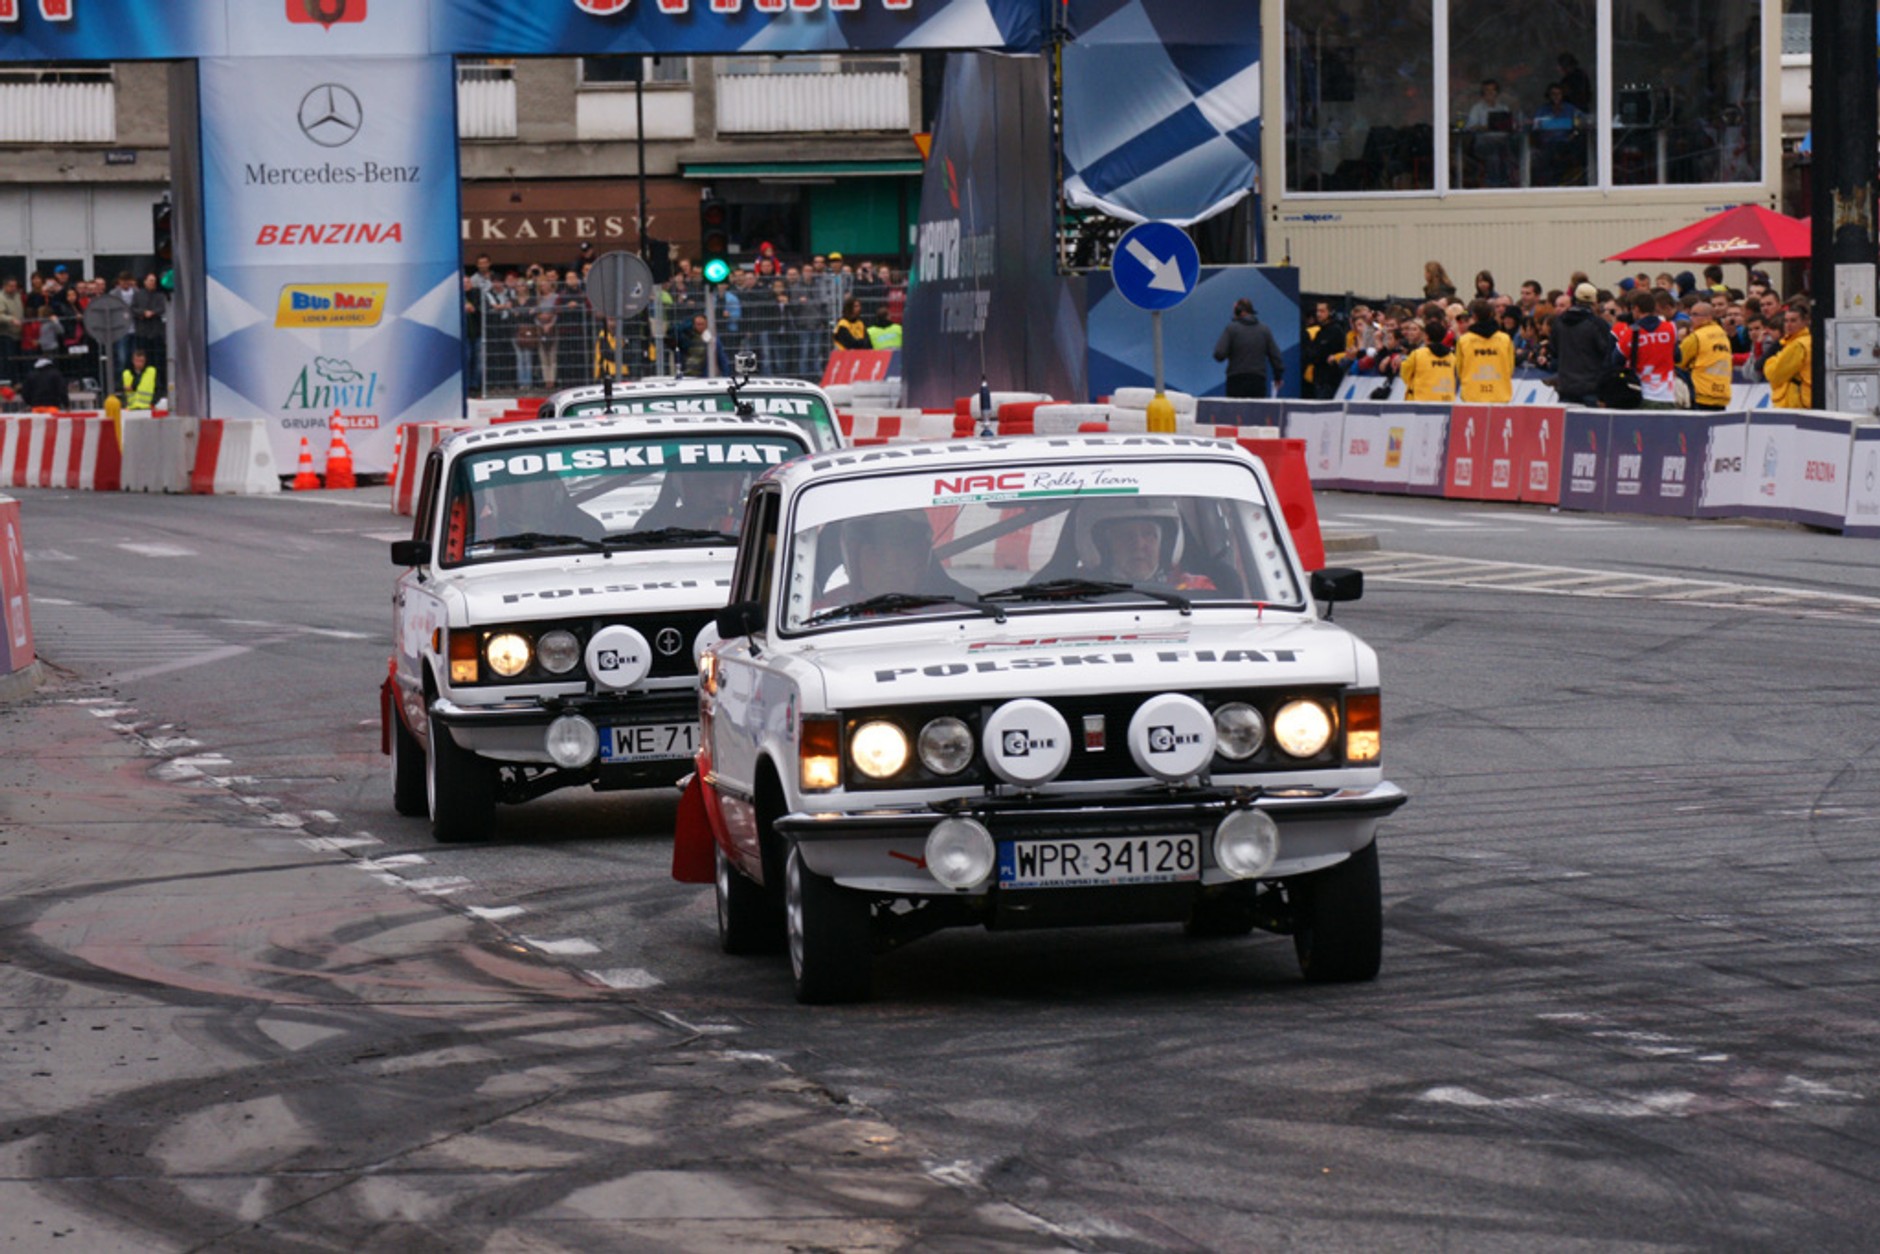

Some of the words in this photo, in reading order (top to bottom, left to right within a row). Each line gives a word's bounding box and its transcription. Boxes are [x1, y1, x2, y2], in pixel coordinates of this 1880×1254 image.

[245, 162, 421, 185] Mercedes-Benz
[256, 222, 403, 245] BENZINA
[282, 363, 378, 410] Anwil
[281, 418, 326, 430] GRUPA
[466, 420, 616, 444] RALLY
[471, 444, 664, 482] POLSKI
[677, 443, 789, 464] FIAT
[811, 440, 1015, 472] RALLY
[1047, 437, 1235, 451] TEAM
[934, 473, 1025, 495] NAC
[1032, 472, 1085, 495] Rally
[1091, 468, 1139, 485] Team
[503, 580, 698, 604] POLSKI
[873, 653, 1135, 684] POLSKI
[1155, 648, 1306, 663] FIAT
[616, 728, 655, 754] WE
[664, 724, 701, 752] 71
[1017, 844, 1081, 877] WPR
[1093, 838, 1195, 875] 34128
[1001, 867, 1014, 876] PL
